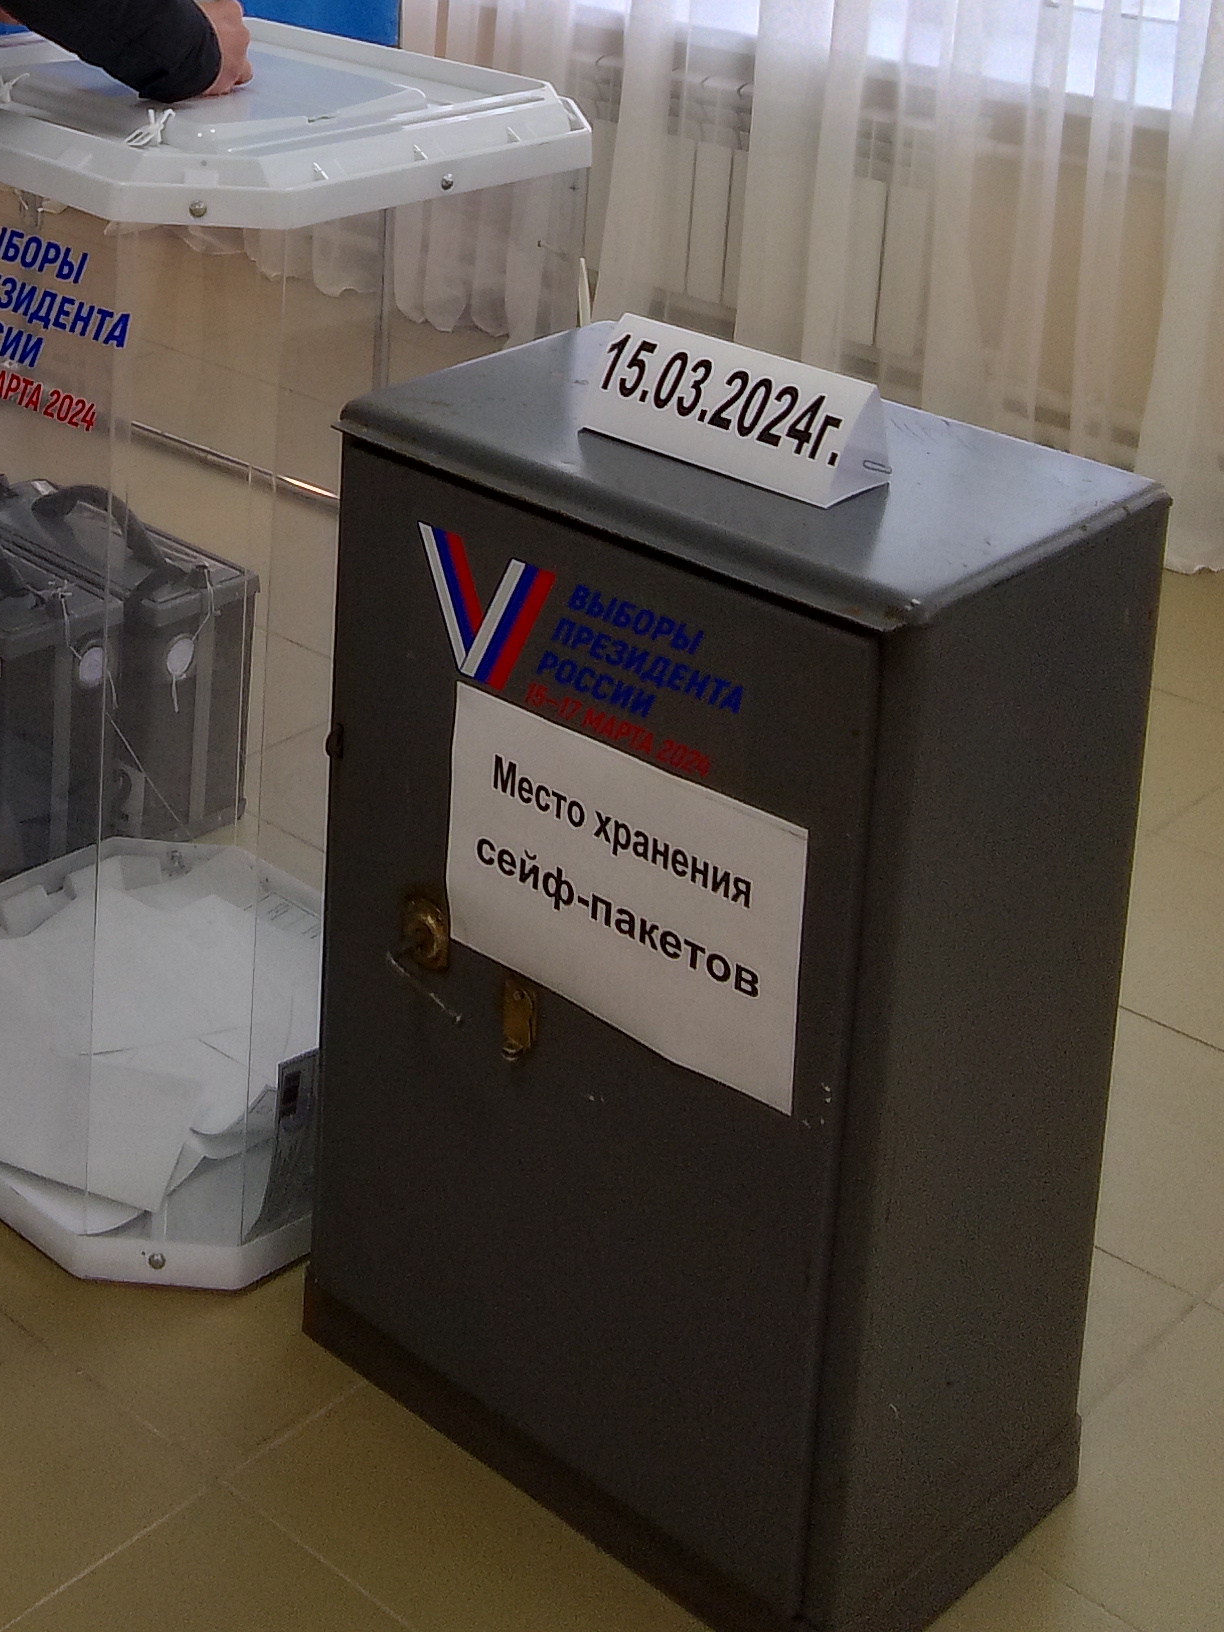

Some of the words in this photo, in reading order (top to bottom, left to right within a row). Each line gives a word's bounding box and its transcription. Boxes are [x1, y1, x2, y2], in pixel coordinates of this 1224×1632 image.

[43, 390, 96, 432] 2024
[601, 334, 842, 466] 15.03.2024г.
[567, 584, 704, 654] ВЫБОРЫ
[536, 650, 655, 718] РОССИИ
[552, 617, 743, 714] ПРЕЗИДЕНТА
[582, 708, 653, 754] МАРТА
[656, 739, 710, 777] 2024
[493, 754, 584, 827] Место
[594, 810, 752, 908] хранения
[476, 837, 760, 999] сейф-пакетов
